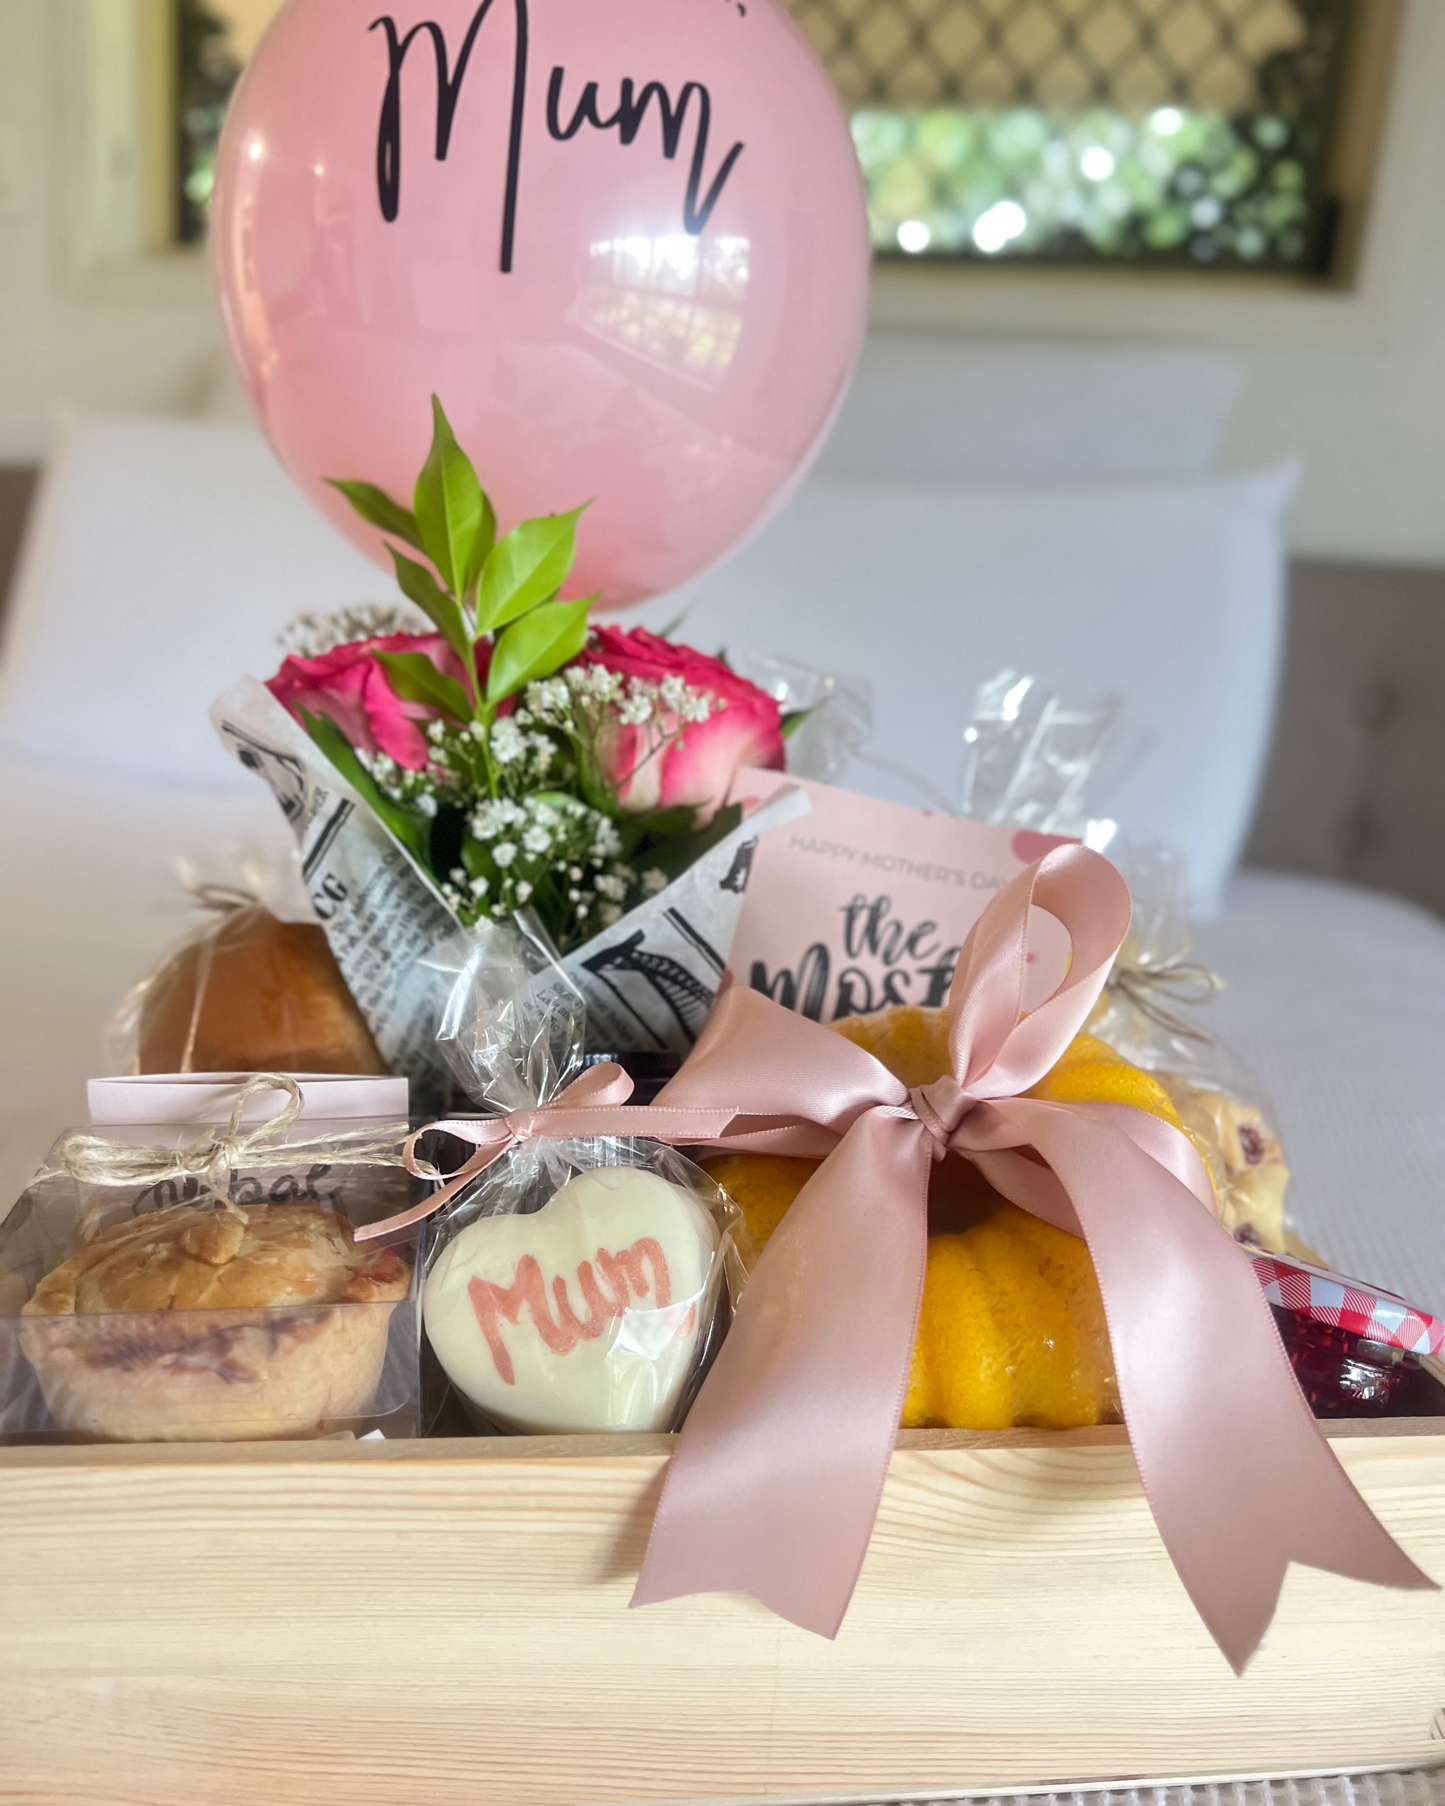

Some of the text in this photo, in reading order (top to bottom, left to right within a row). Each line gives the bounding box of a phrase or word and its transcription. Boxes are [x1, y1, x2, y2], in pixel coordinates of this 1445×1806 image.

[367, 0, 745, 274] Mum
[789, 834, 859, 860] HAPPY
[861, 851, 966, 888] MOTHER'S
[840, 892, 942, 966] the
[467, 1237, 696, 1386] Mum
